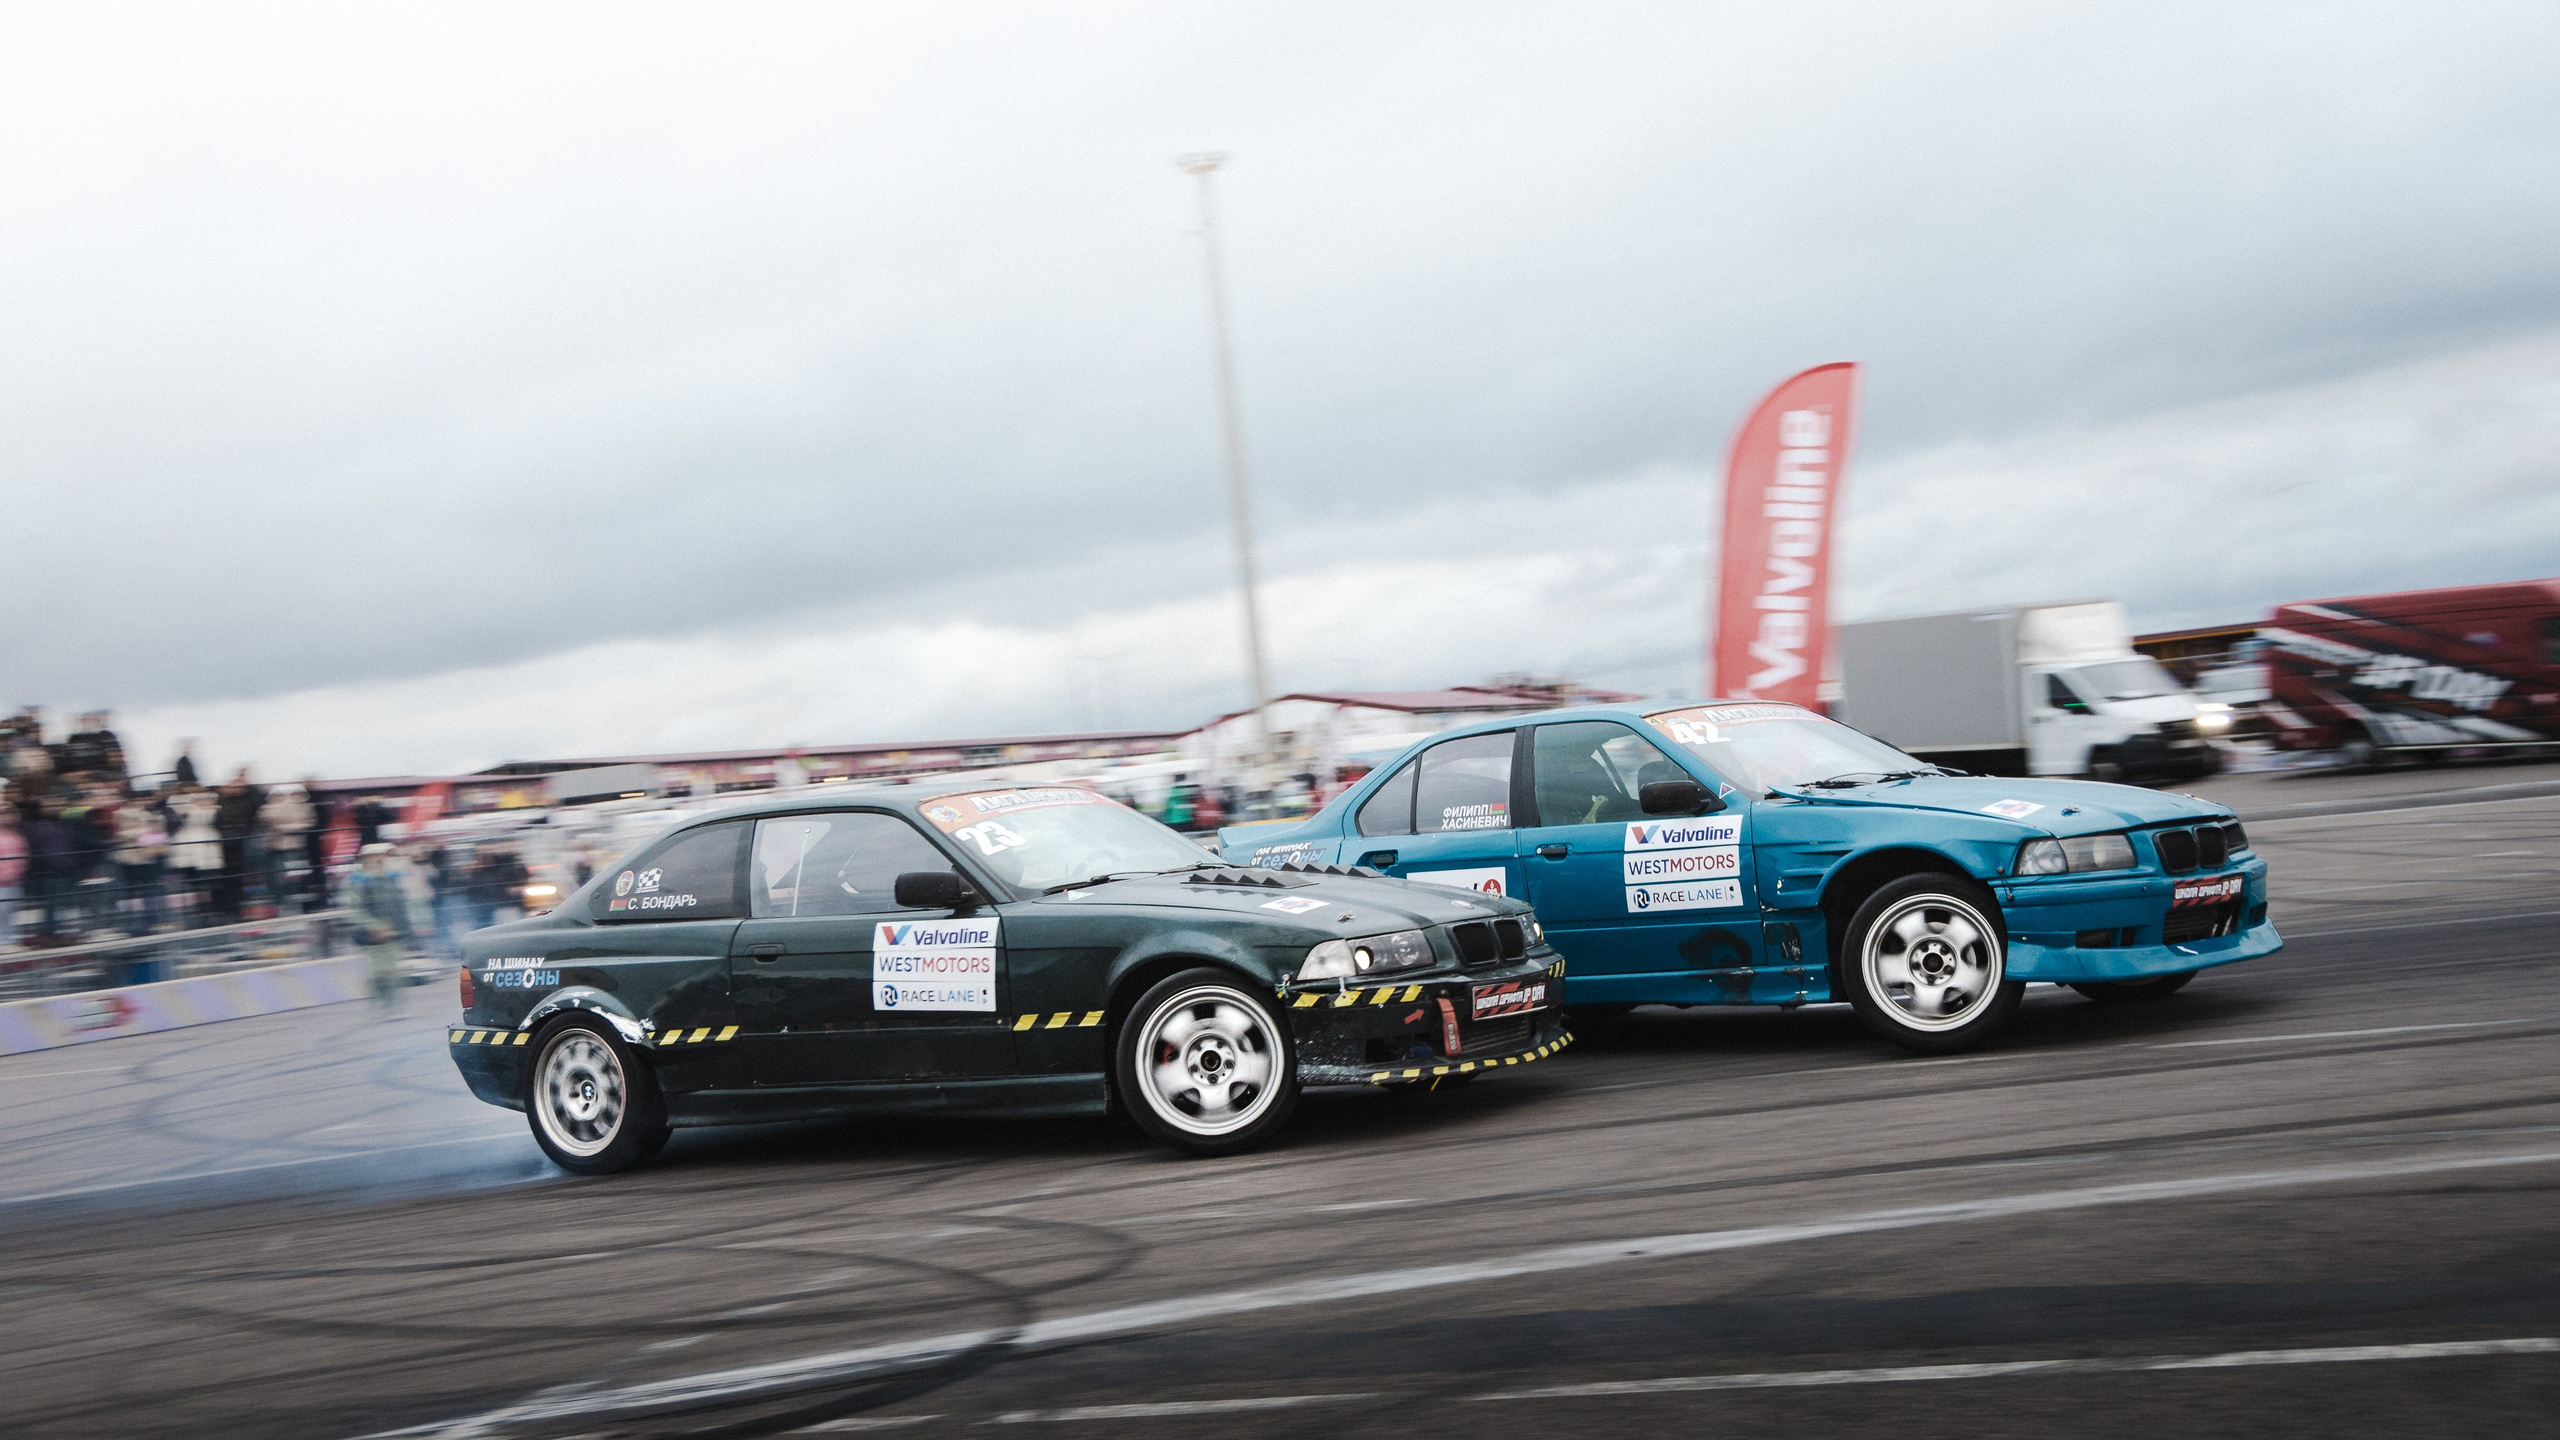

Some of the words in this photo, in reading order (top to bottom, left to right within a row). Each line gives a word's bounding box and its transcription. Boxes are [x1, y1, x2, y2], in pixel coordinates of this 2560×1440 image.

[1746, 407, 1832, 691] Valvoline
[1669, 721, 1732, 745] 42
[1443, 804, 1489, 818] ФИЛИПП
[1441, 815, 1508, 830] ХАСИНЕВИЧ
[955, 821, 1026, 856] 23
[1662, 827, 1734, 843] Valvoline
[1628, 854, 1735, 876] WESTMOTORS
[627, 897, 639, 910] С.
[641, 894, 698, 910] БОНДАРЬ
[1652, 891, 1685, 904] RACE
[1687, 888, 1723, 901] LANE
[913, 928, 989, 946] Valvoline
[487, 958, 502, 970] НА
[504, 956, 545, 969] ШИНАХ
[879, 956, 991, 974] WESTMOTORS
[901, 990, 935, 1002] RACE
[938, 990, 975, 1002] LANE
